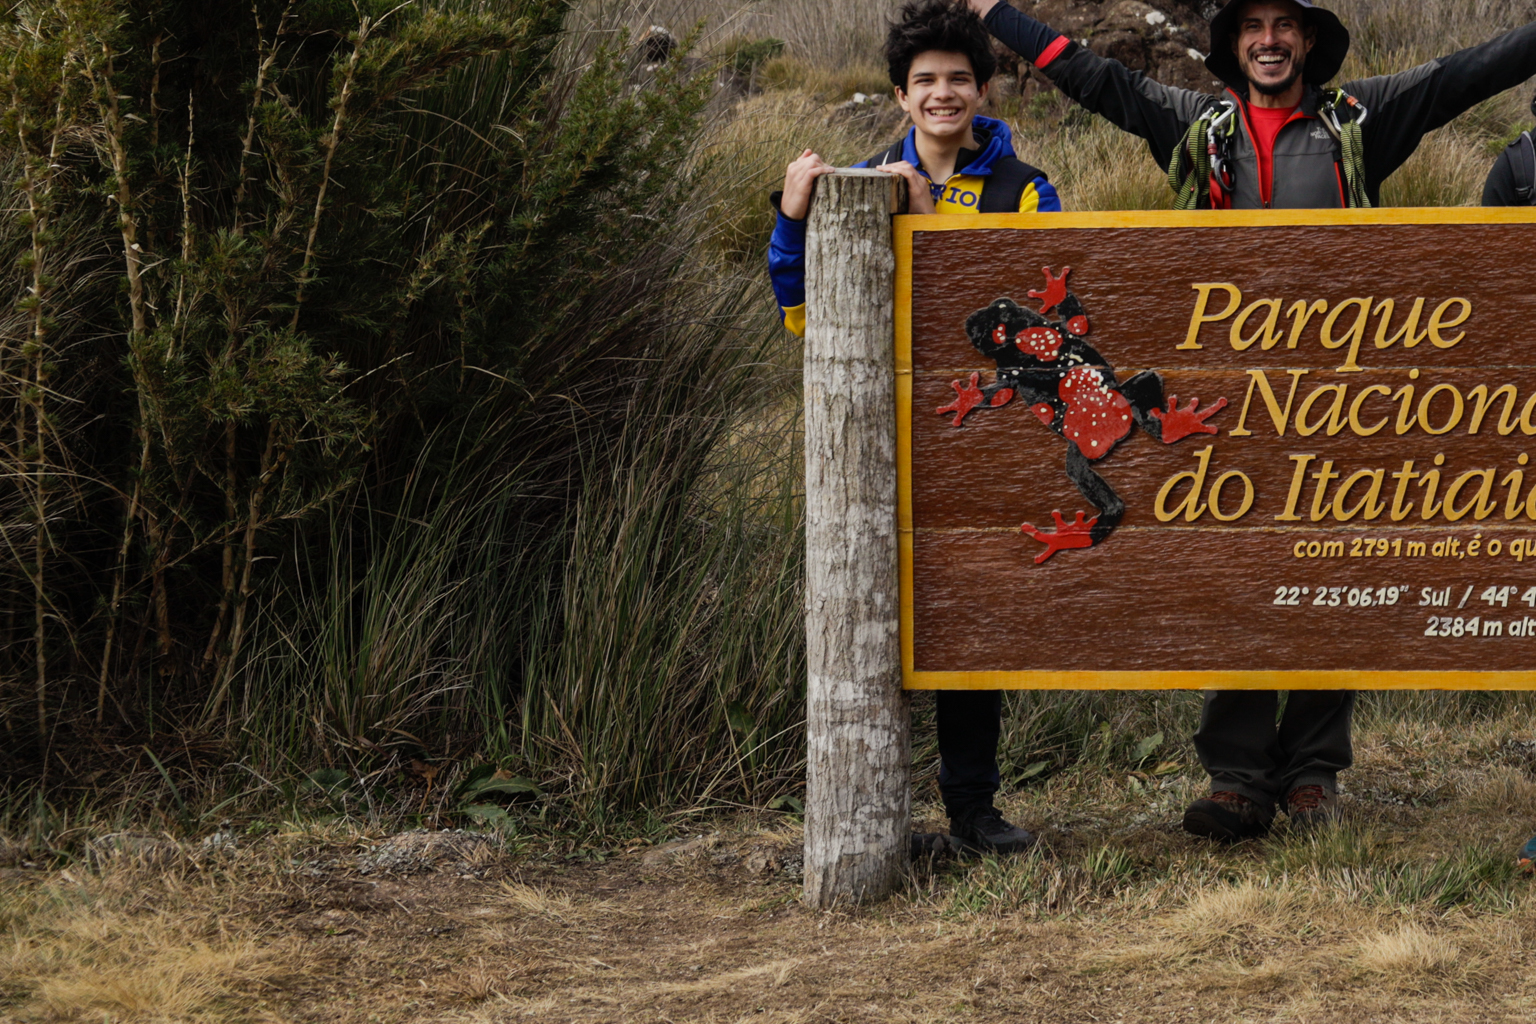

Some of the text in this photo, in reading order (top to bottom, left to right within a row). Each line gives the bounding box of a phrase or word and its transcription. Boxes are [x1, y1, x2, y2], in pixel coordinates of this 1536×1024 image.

[1176, 282, 1473, 372] Parque
[1154, 445, 1255, 523] do
[1293, 539, 1345, 558] com
[1349, 537, 1403, 557] 2791
[1406, 540, 1427, 557] m
[1486, 538, 1502, 556] o
[1272, 585, 1310, 606] 22°
[1418, 586, 1452, 607] Sul
[1457, 584, 1474, 609] /
[1480, 585, 1518, 608] 44°
[1424, 615, 1480, 638] 2384
[1482, 620, 1503, 637] m
